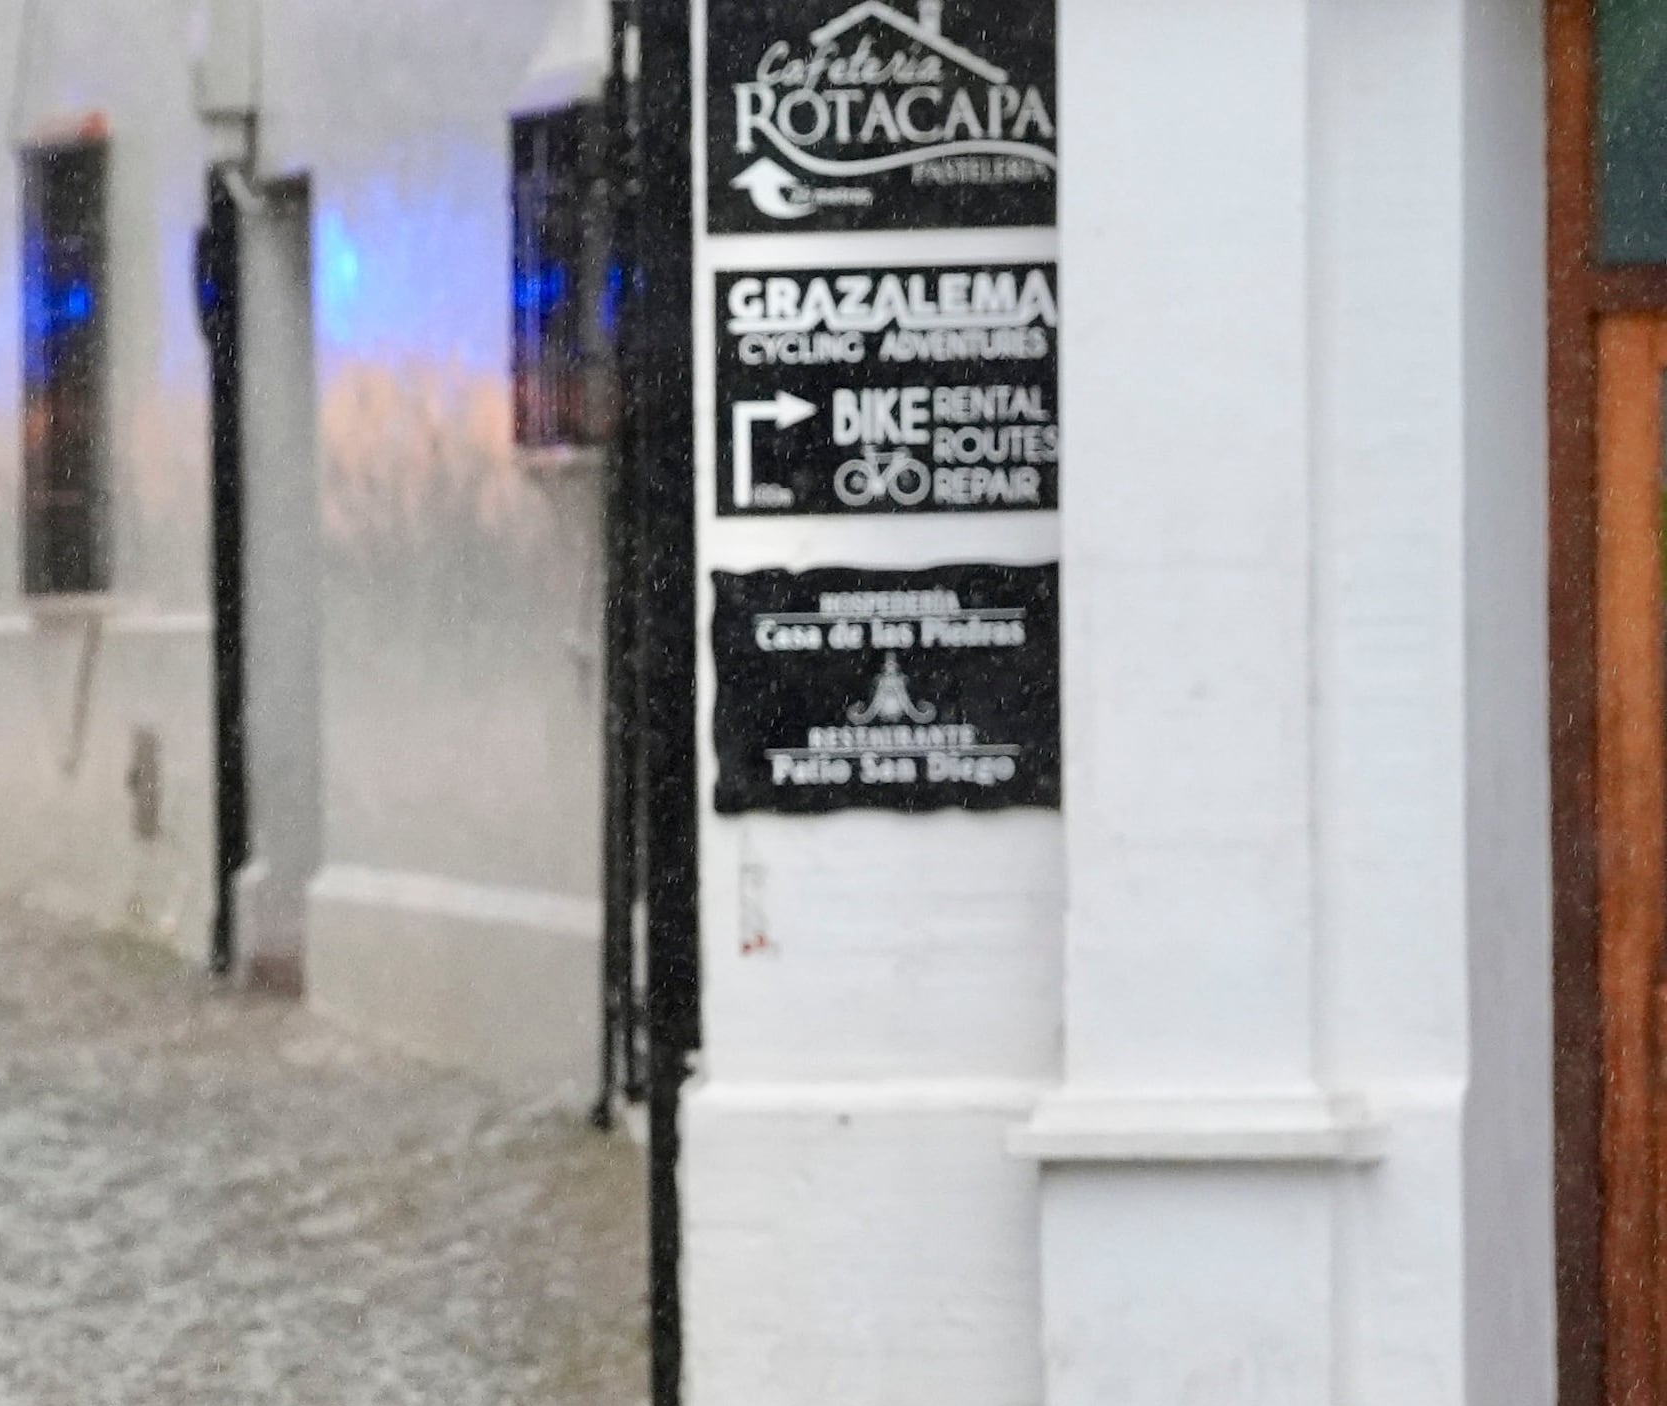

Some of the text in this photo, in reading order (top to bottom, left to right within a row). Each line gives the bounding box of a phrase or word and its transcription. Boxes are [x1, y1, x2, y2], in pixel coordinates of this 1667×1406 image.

[733, 81, 1055, 154] ROTACAPA
[727, 270, 1056, 327] GRAZALEMA
[738, 327, 1048, 365] CYCLING ADVENTURES
[832, 387, 931, 446] BIKE
[933, 386, 1047, 422] RENTAL
[933, 426, 1057, 463] ROUTES
[934, 466, 1040, 504] REPAIR
[755, 619, 822, 651] Casa
[828, 617, 864, 650] de
[920, 614, 1027, 648] Piedras
[808, 724, 977, 749] RESTAURANTE
[772, 751, 1016, 786] Patio San Diego
